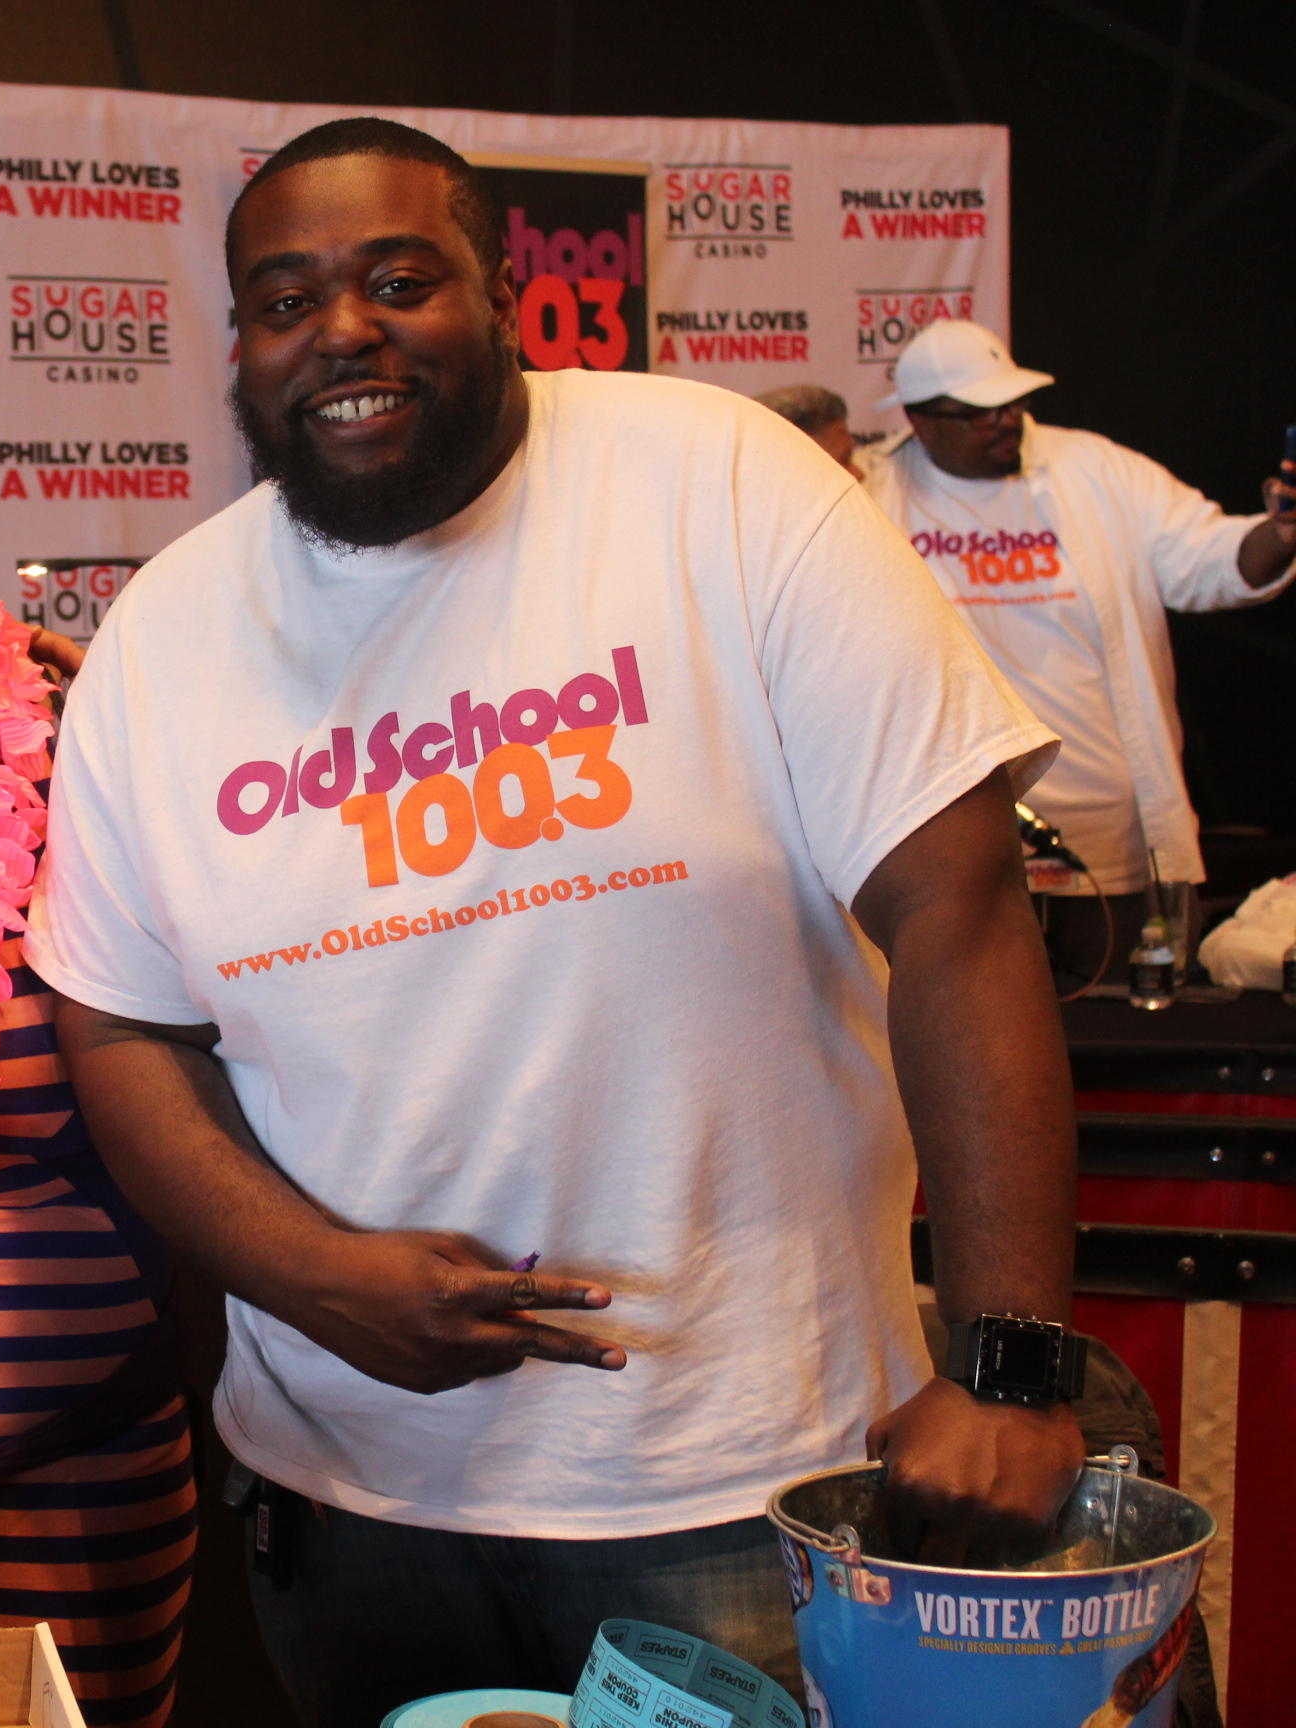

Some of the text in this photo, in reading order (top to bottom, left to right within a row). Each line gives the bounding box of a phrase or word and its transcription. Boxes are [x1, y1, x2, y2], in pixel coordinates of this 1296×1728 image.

[91, 161, 181, 188] LOVES
[666, 173, 792, 202] SUGAR
[27, 186, 182, 224] WINNER
[667, 193, 792, 232] HOUSE
[841, 189, 984, 208] PHILLY LOVES
[842, 213, 986, 239] A WINNER
[502, 207, 642, 286] hool
[694, 243, 767, 259] CASINO
[11, 285, 168, 321] SUGAR
[857, 296, 974, 326] SUGAR
[11, 309, 168, 355] HOUSE
[657, 311, 809, 331] PHILLY LOVES
[657, 335, 810, 364] A WINNER
[46, 366, 139, 383] CASINO
[101, 442, 189, 465] LOVES
[0, 468, 191, 500] A WINNER
[967, 529, 1058, 554] Schoo
[20, 565, 138, 599] SUG
[22, 590, 116, 628] HOU
[340, 725, 633, 888] 100.3
[216, 858, 689, 982] www.OldSchool1003.com
[1061, 1584, 1161, 1639] BOTTLE
[640, 1641, 688, 1660] STAPLES
[918, 1636, 965, 1653] SPECIALLY
[967, 1641, 1012, 1655] DESIGNED
[1014, 1643, 1057, 1656] GROOVES
[601, 1678, 641, 1711] KEEP THIS
[607, 1672, 639, 1699] COUPON
[709, 1666, 757, 1695] STAPLES
